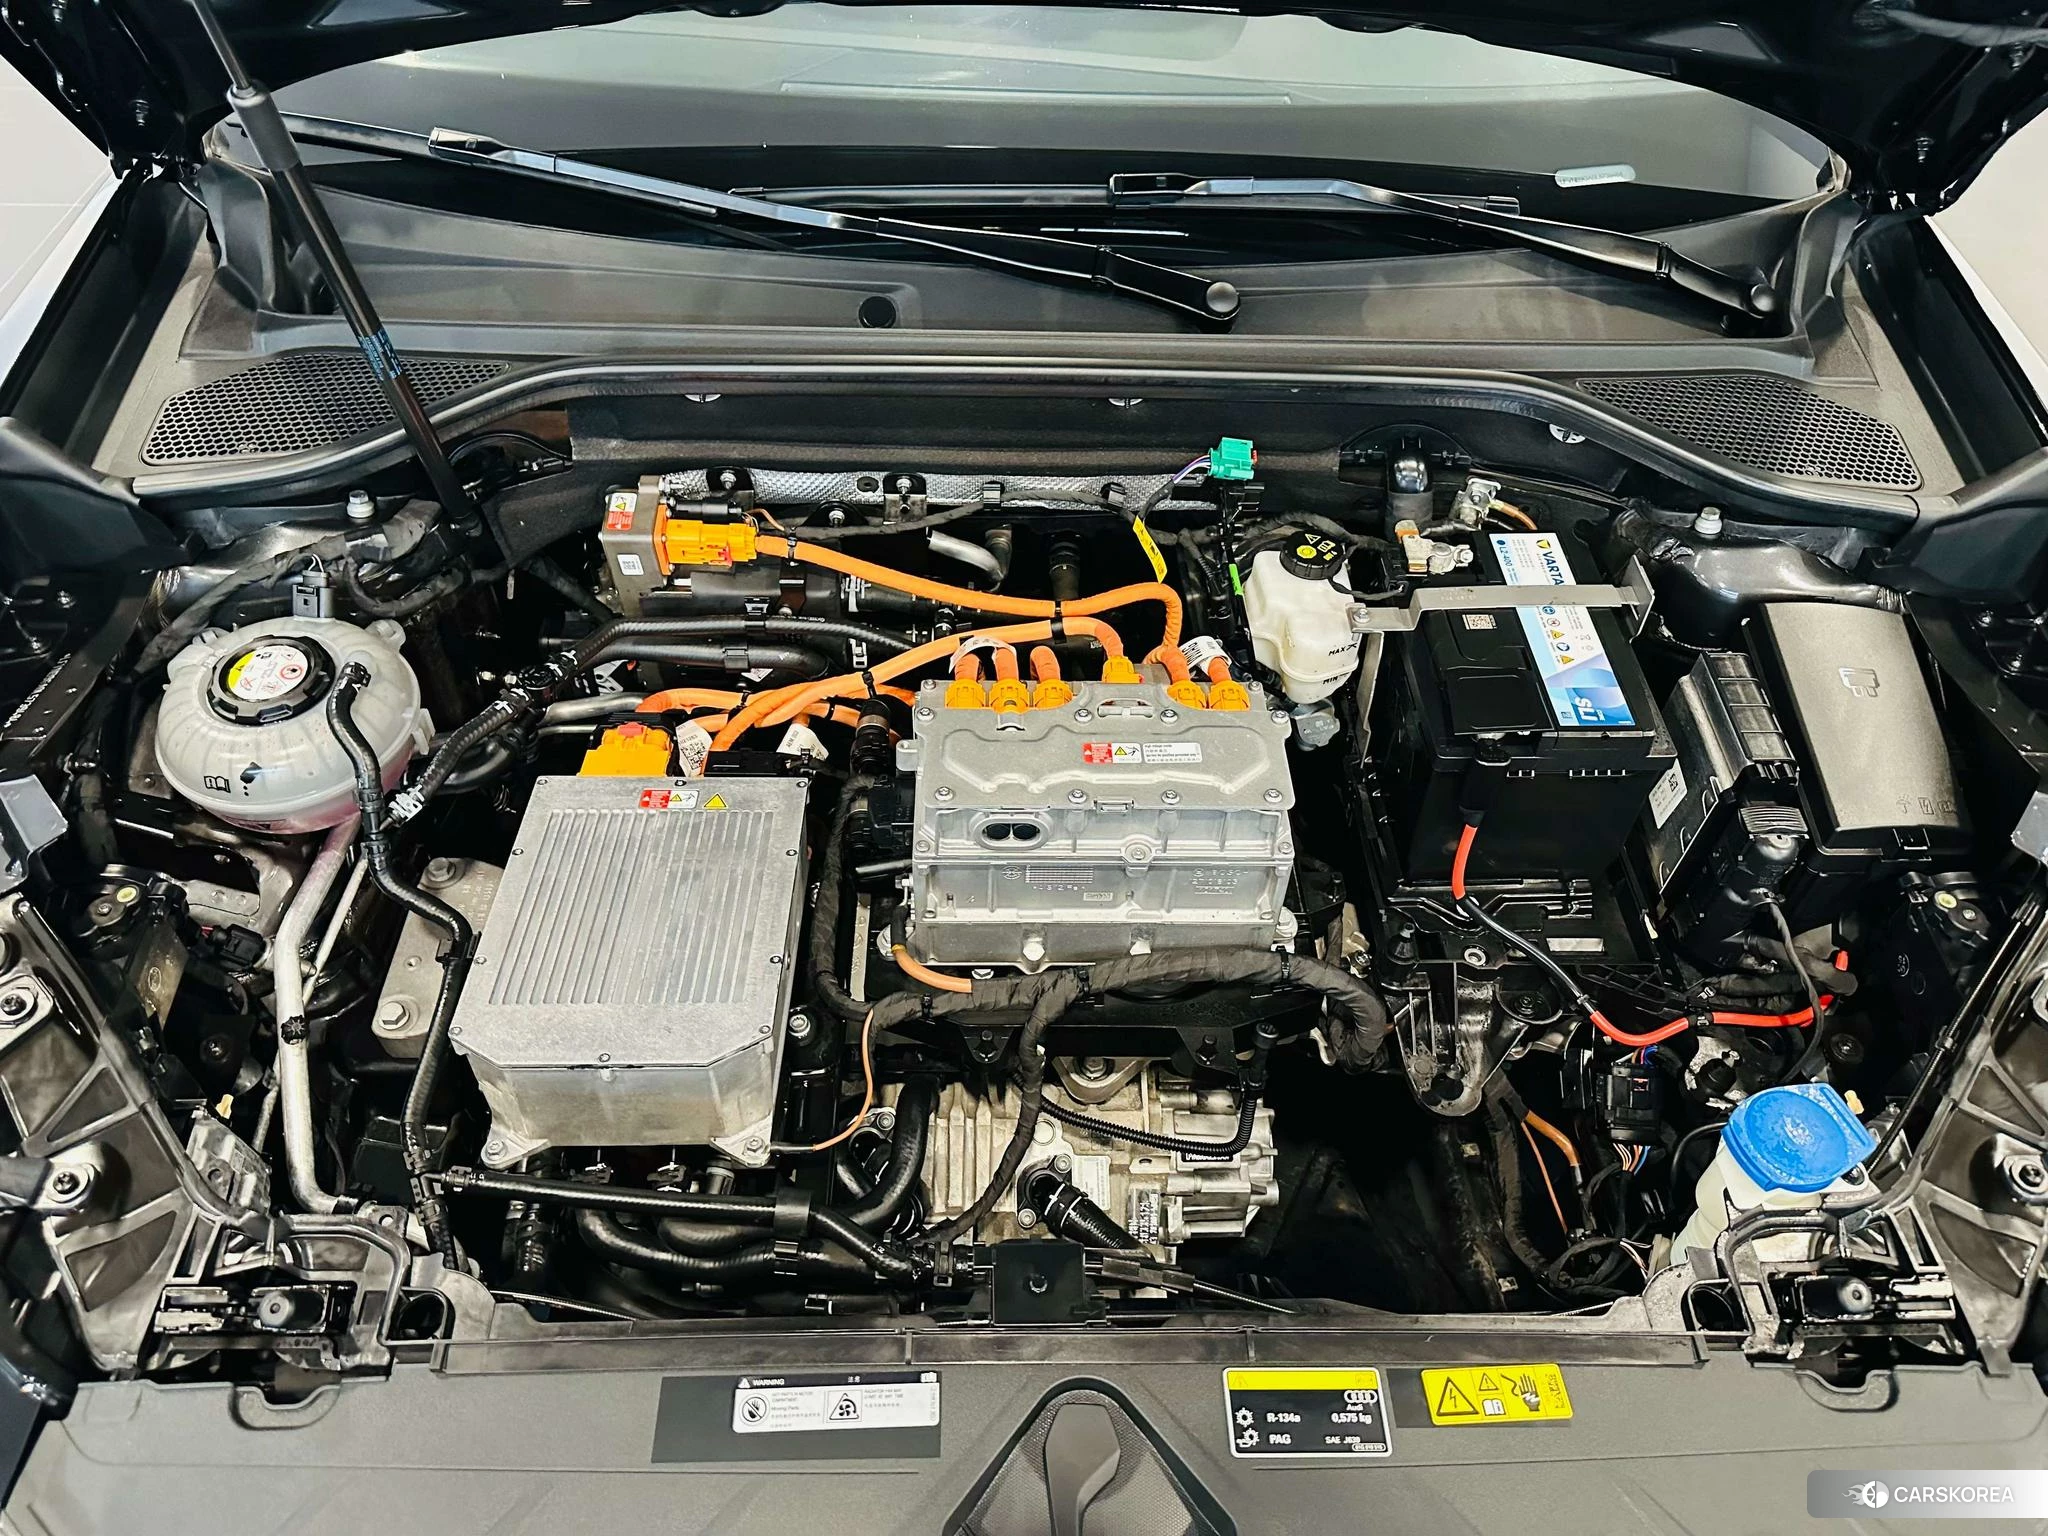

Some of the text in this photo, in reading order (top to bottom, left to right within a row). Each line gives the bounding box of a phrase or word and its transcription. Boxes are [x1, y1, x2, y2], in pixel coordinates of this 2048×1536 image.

[1543, 551, 1565, 585] VARTA
[1328, 646, 1346, 656] MAX
[1323, 676, 1338, 685] MIN
[753, 1378, 785, 1386] WARNING
[1346, 1403, 1364, 1411] Audi
[1266, 1412, 1372, 1425] R-134a 0,575 kg
[1268, 1433, 1292, 1445] PAG
[1324, 1436, 1341, 1444] SAE
